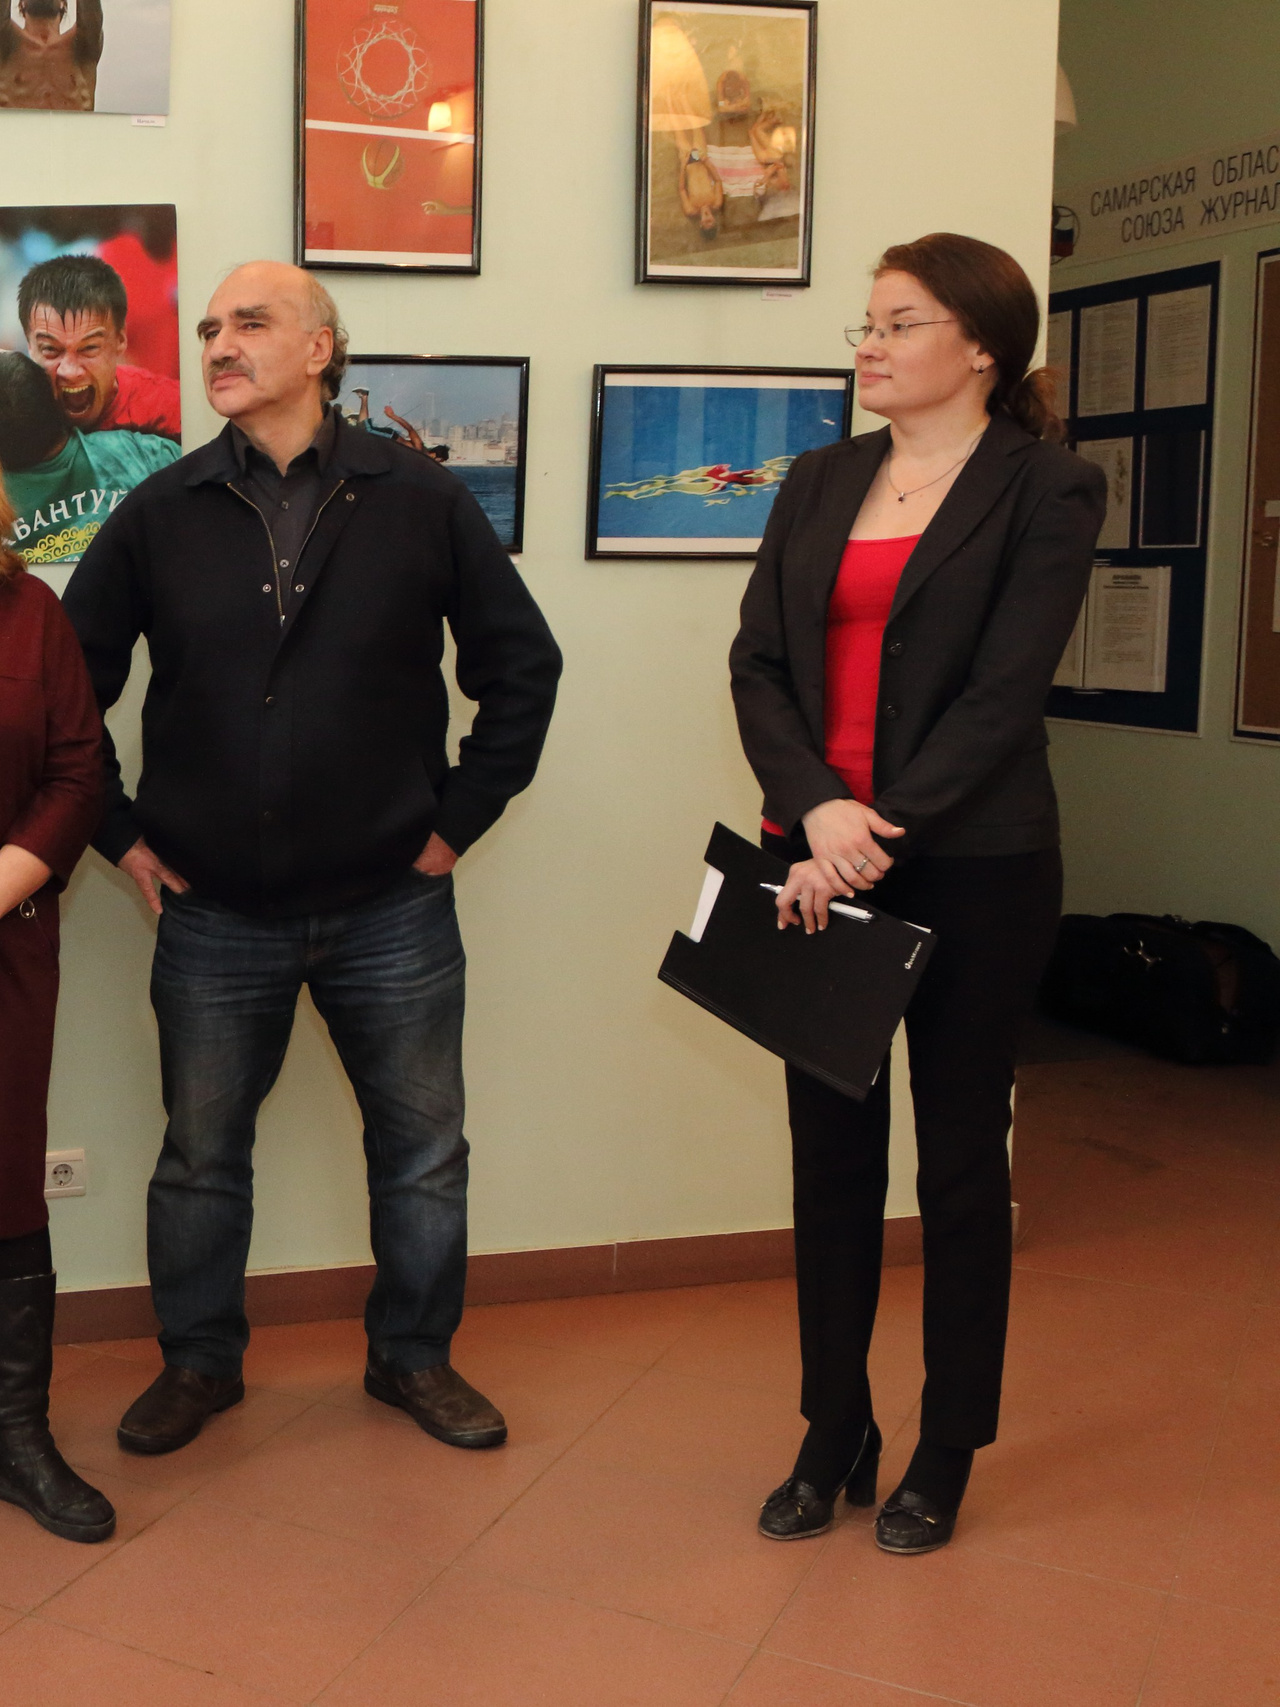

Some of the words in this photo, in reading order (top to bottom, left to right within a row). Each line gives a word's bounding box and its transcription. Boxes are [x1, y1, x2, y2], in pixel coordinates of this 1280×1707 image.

[1090, 166, 1196, 217] САМАРСКАЯ
[1121, 206, 1185, 243] СОЮЗА
[1, 488, 128, 546] БАНТУЙ
